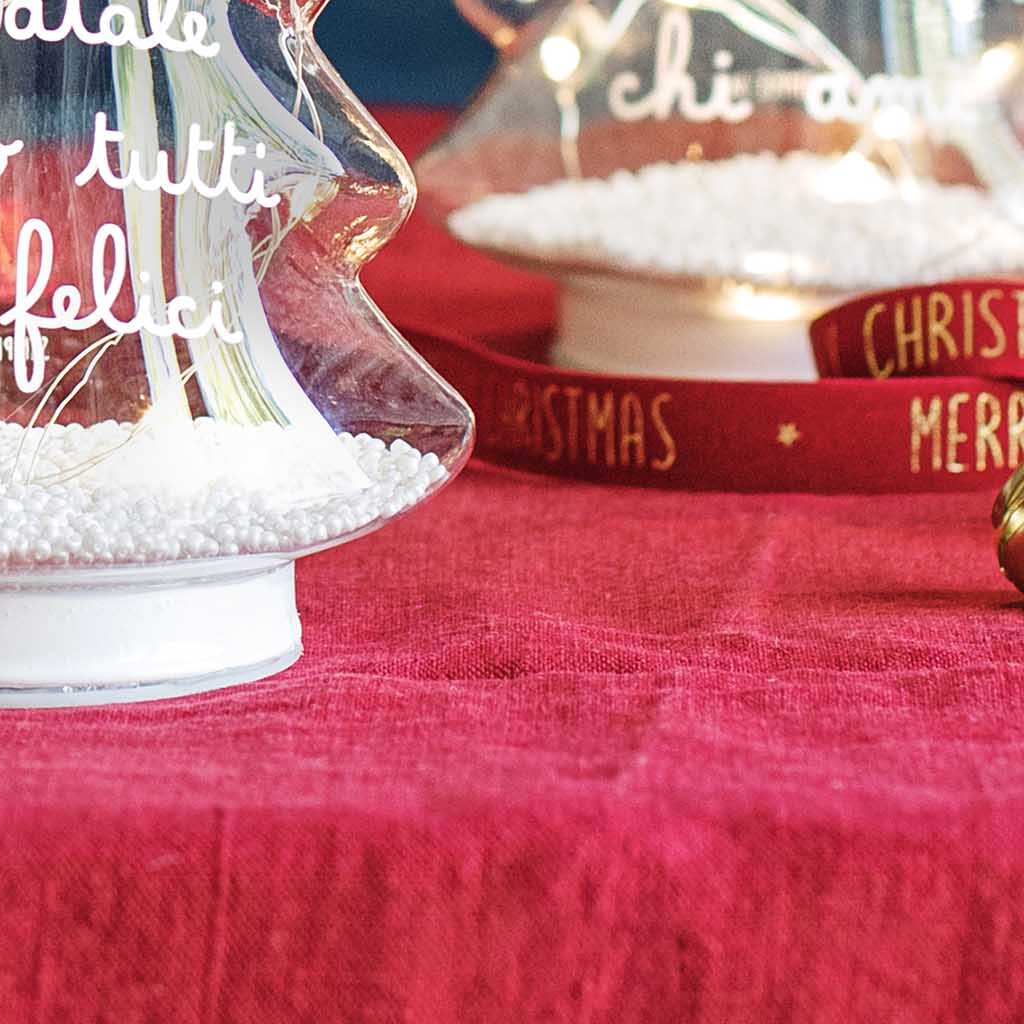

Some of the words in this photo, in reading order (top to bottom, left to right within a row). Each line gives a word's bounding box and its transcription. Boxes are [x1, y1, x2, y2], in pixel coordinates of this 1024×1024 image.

[608, 8, 753, 122] chi
[75, 112, 281, 208] tutti
[0, 217, 244, 394] felici
